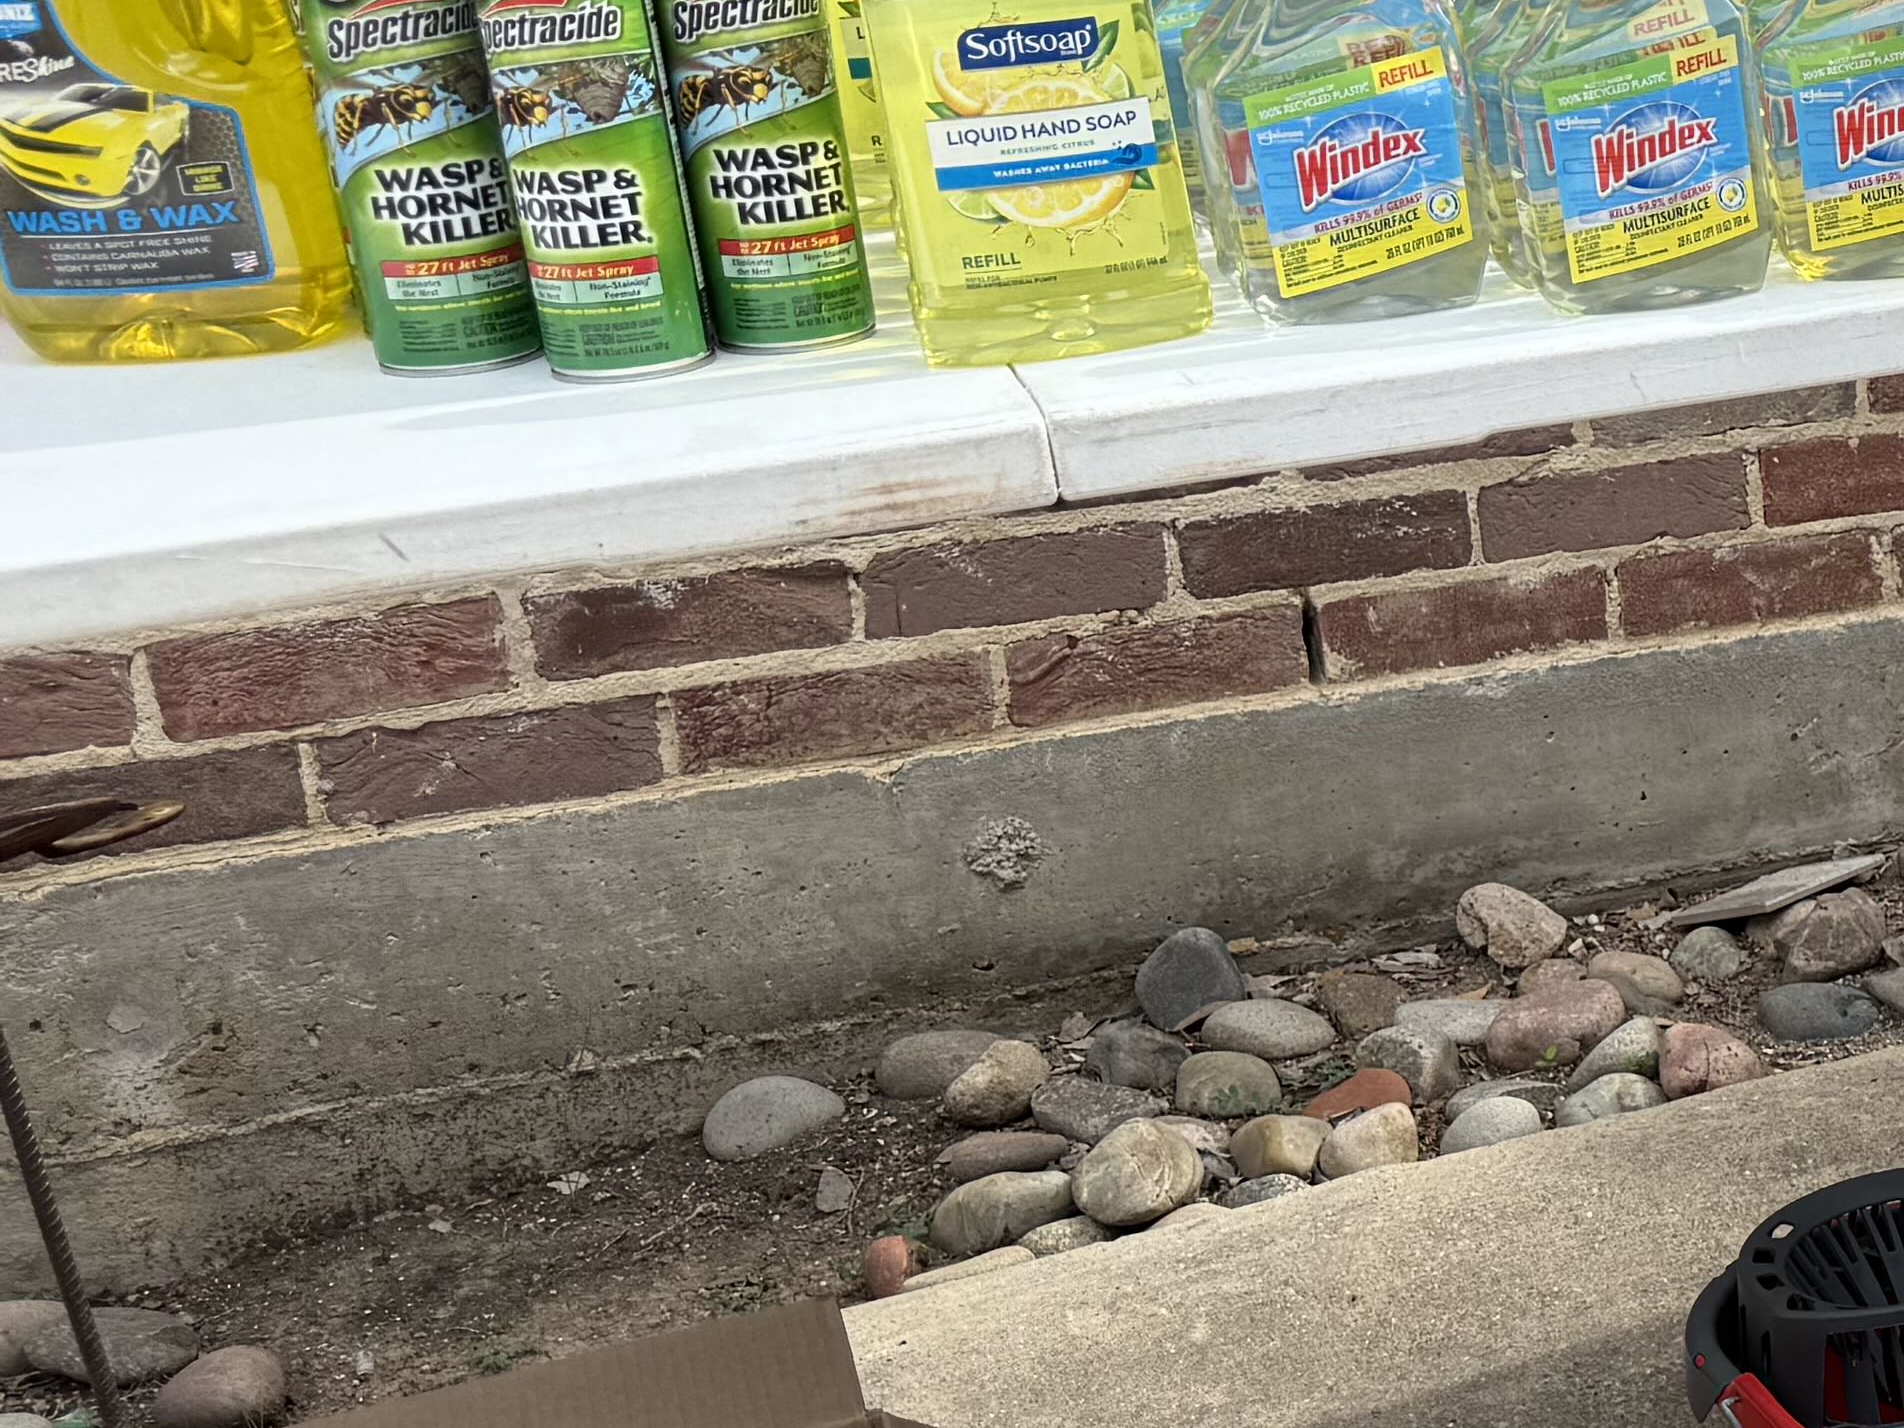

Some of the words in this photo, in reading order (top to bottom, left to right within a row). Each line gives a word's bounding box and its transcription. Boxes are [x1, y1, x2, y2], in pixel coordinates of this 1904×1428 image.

[964, 24, 1093, 63] Softsoap
[1675, 48, 1728, 78] REFILL
[1582, 81, 1630, 103] RECYCLED
[1630, 70, 1668, 91] PLASTIC
[945, 125, 1018, 148] LIQUID
[1021, 117, 1081, 140] HAND
[1084, 109, 1138, 133] SOAP
[1060, 138, 1096, 150] CITRUS
[712, 140, 820, 173] WASP
[823, 139, 840, 161] &
[1295, 126, 1426, 210] Windex
[1591, 113, 1718, 198] Windex
[512, 169, 608, 195] WASP
[613, 168, 640, 190] &
[709, 162, 843, 199] HORNET
[371, 180, 509, 220] HORNET
[1622, 197, 1712, 234] MULTISURFACE
[6, 208, 107, 234] WASH
[115, 208, 142, 232] &
[149, 200, 241, 227] WAX
[1314, 218, 1342, 235] KILLS
[1329, 208, 1421, 247] MULTISURFACE
[530, 220, 654, 249] KILLER.
[750, 240, 772, 254] 27
[774, 241, 786, 251] ft
[789, 238, 808, 251] Jet
[811, 234, 841, 250] Spray
[91, 262, 128, 274] STRIP
[129, 260, 160, 272] WAX
[180, 246, 212, 258] WAX
[961, 252, 1022, 270] REFILL
